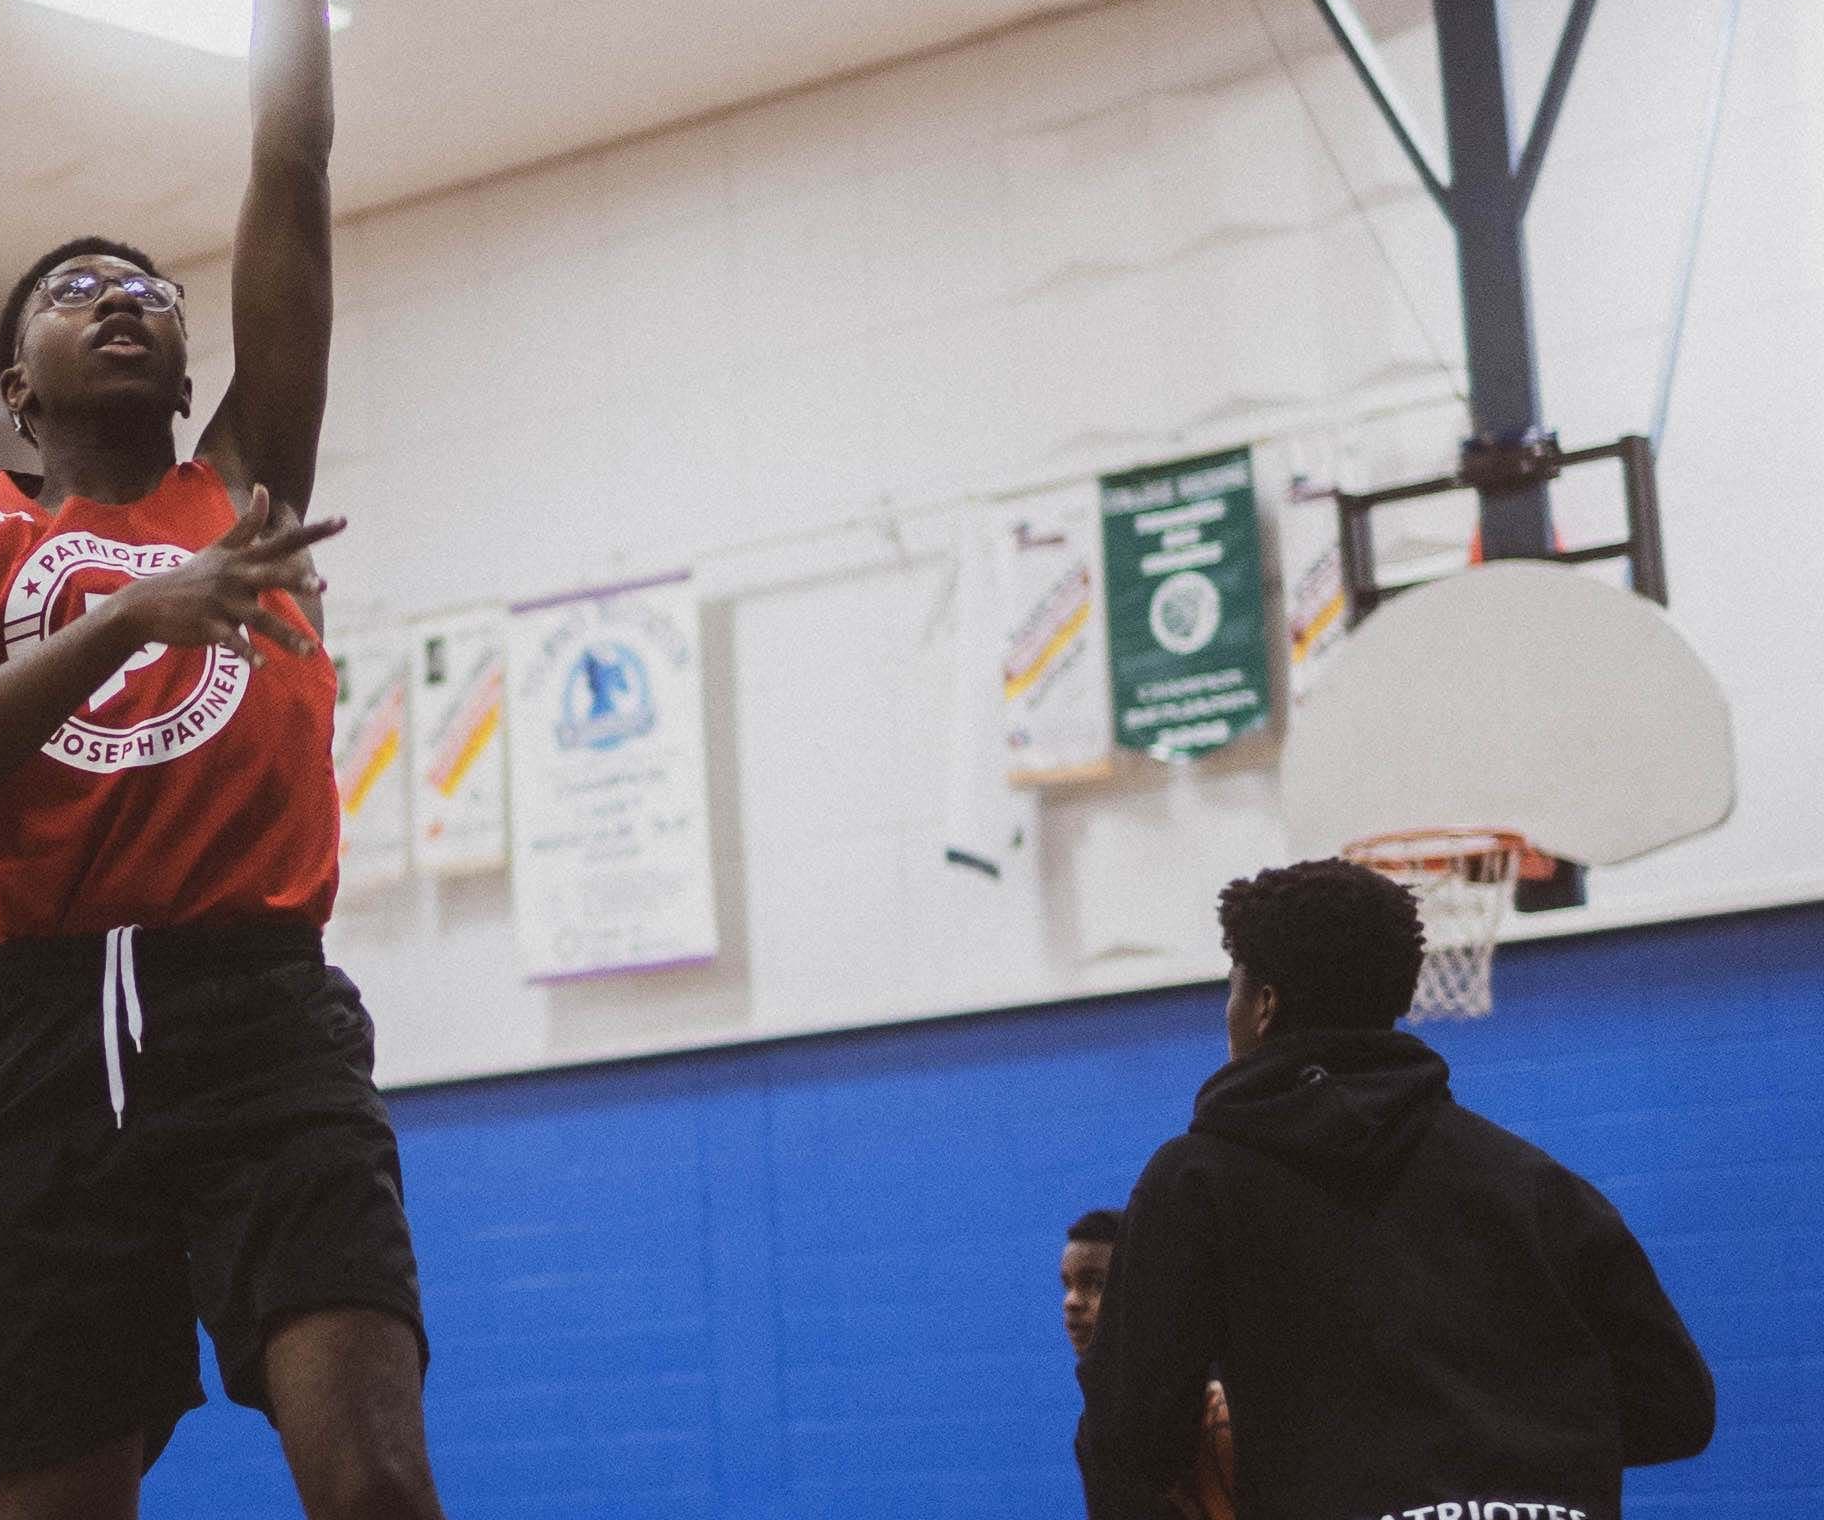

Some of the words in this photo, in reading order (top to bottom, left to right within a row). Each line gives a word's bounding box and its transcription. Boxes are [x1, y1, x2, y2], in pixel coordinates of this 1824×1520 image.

[38, 538, 184, 574] PATRIOTES
[49, 726, 155, 764] JOSEPH
[160, 641, 242, 752] PAPINEAU
